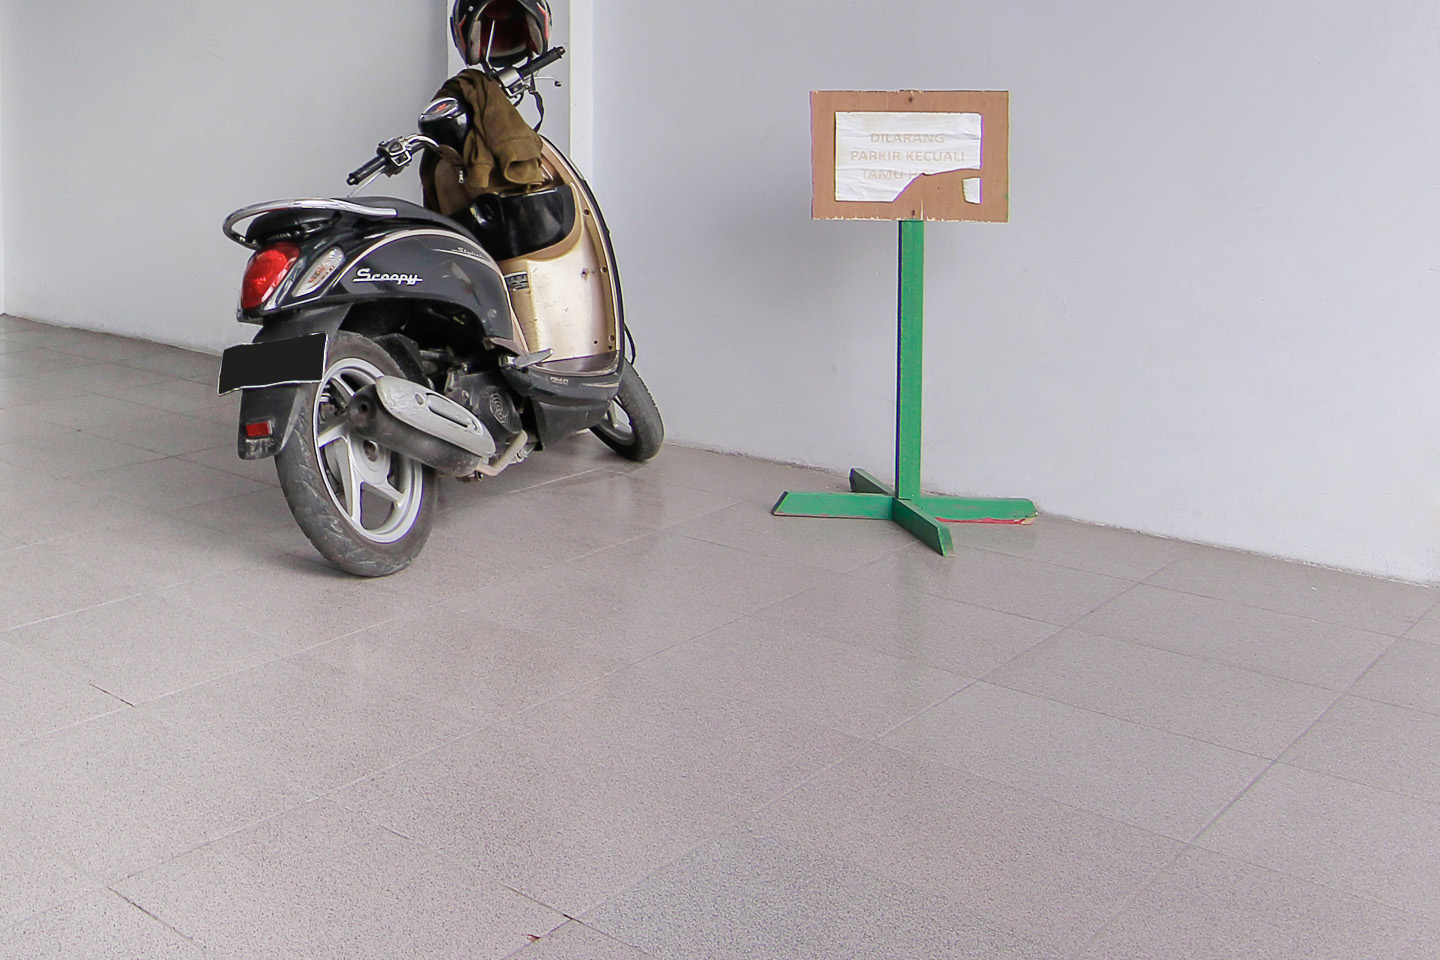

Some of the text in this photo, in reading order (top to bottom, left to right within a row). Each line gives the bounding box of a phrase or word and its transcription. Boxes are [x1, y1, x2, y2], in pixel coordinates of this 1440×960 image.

[870, 133, 945, 143] DILARANG
[850, 150, 965, 162] PARKIR KECUALI
[862, 169, 903, 179] TAMU
[352, 267, 423, 285] Scoopy
